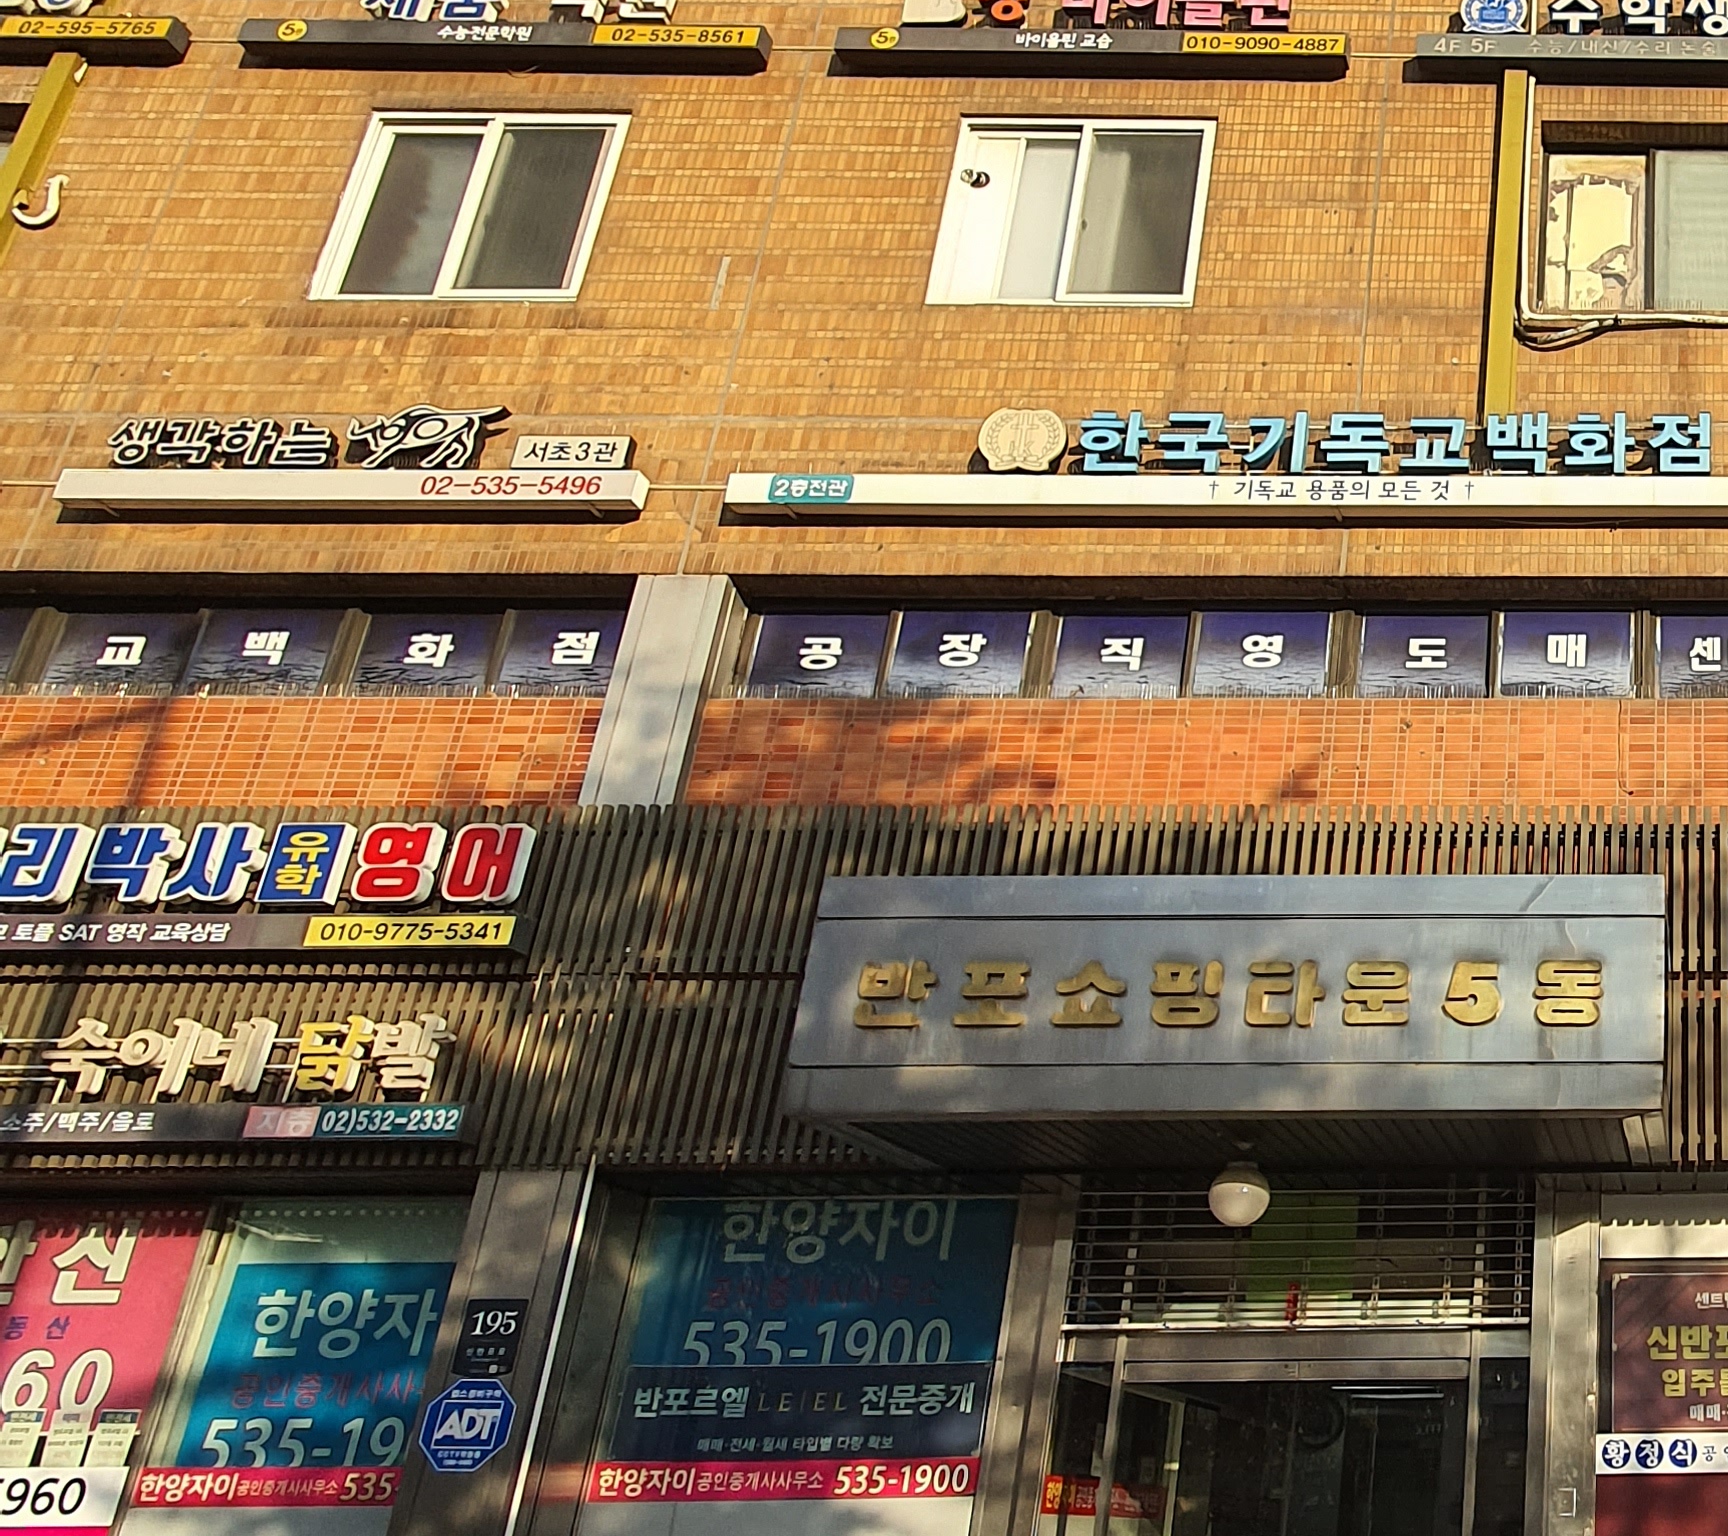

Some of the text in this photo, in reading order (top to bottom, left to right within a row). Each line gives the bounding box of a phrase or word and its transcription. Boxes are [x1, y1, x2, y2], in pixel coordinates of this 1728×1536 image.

[19, 21, 156, 35] 02-595-5765
[611, 28, 745, 45] 02-535-8561
[1016, 33, 1339, 53] 바이올린 교습 010-9090-4887
[1434, 38, 1461, 53] 4F
[1470, 37, 1496, 53] 5F
[107, 417, 618, 466] 생각하는 서초3관
[1079, 411, 1713, 475] 한국기독교백화점
[420, 476, 602, 496] 02-535-5496
[1233, 480, 1297, 500] 기독교
[1306, 480, 1369, 500] 용품의
[1378, 480, 1422, 500] 모든
[1431, 479, 1450, 500] 것
[356, 826, 518, 901] 영어
[11, 922, 502, 943] 토플 SAT 영작 교육상담 010-9775-5341
[853, 959, 1604, 1029] 반포쇼핑타운5동
[296, 1014, 458, 1091] 닭발
[320, 1107, 459, 1133] 02)532-2332
[722, 1199, 956, 1264] 한양자이
[469, 1311, 519, 1336] 195
[684, 1319, 952, 1364] 535-1900
[231, 1370, 425, 1409] 공인중개사사
[634, 1382, 976, 1419] 반포르엘 전문중개
[436, 1408, 502, 1441] ADT
[202, 1416, 412, 1468] 535-19
[0, 1478, 86, 1516] 960
[139, 1472, 239, 1503] 한양자이
[338, 1471, 400, 1502] 535
[599, 1467, 694, 1497] 한양자이
[832, 1463, 970, 1495] 535-1900
